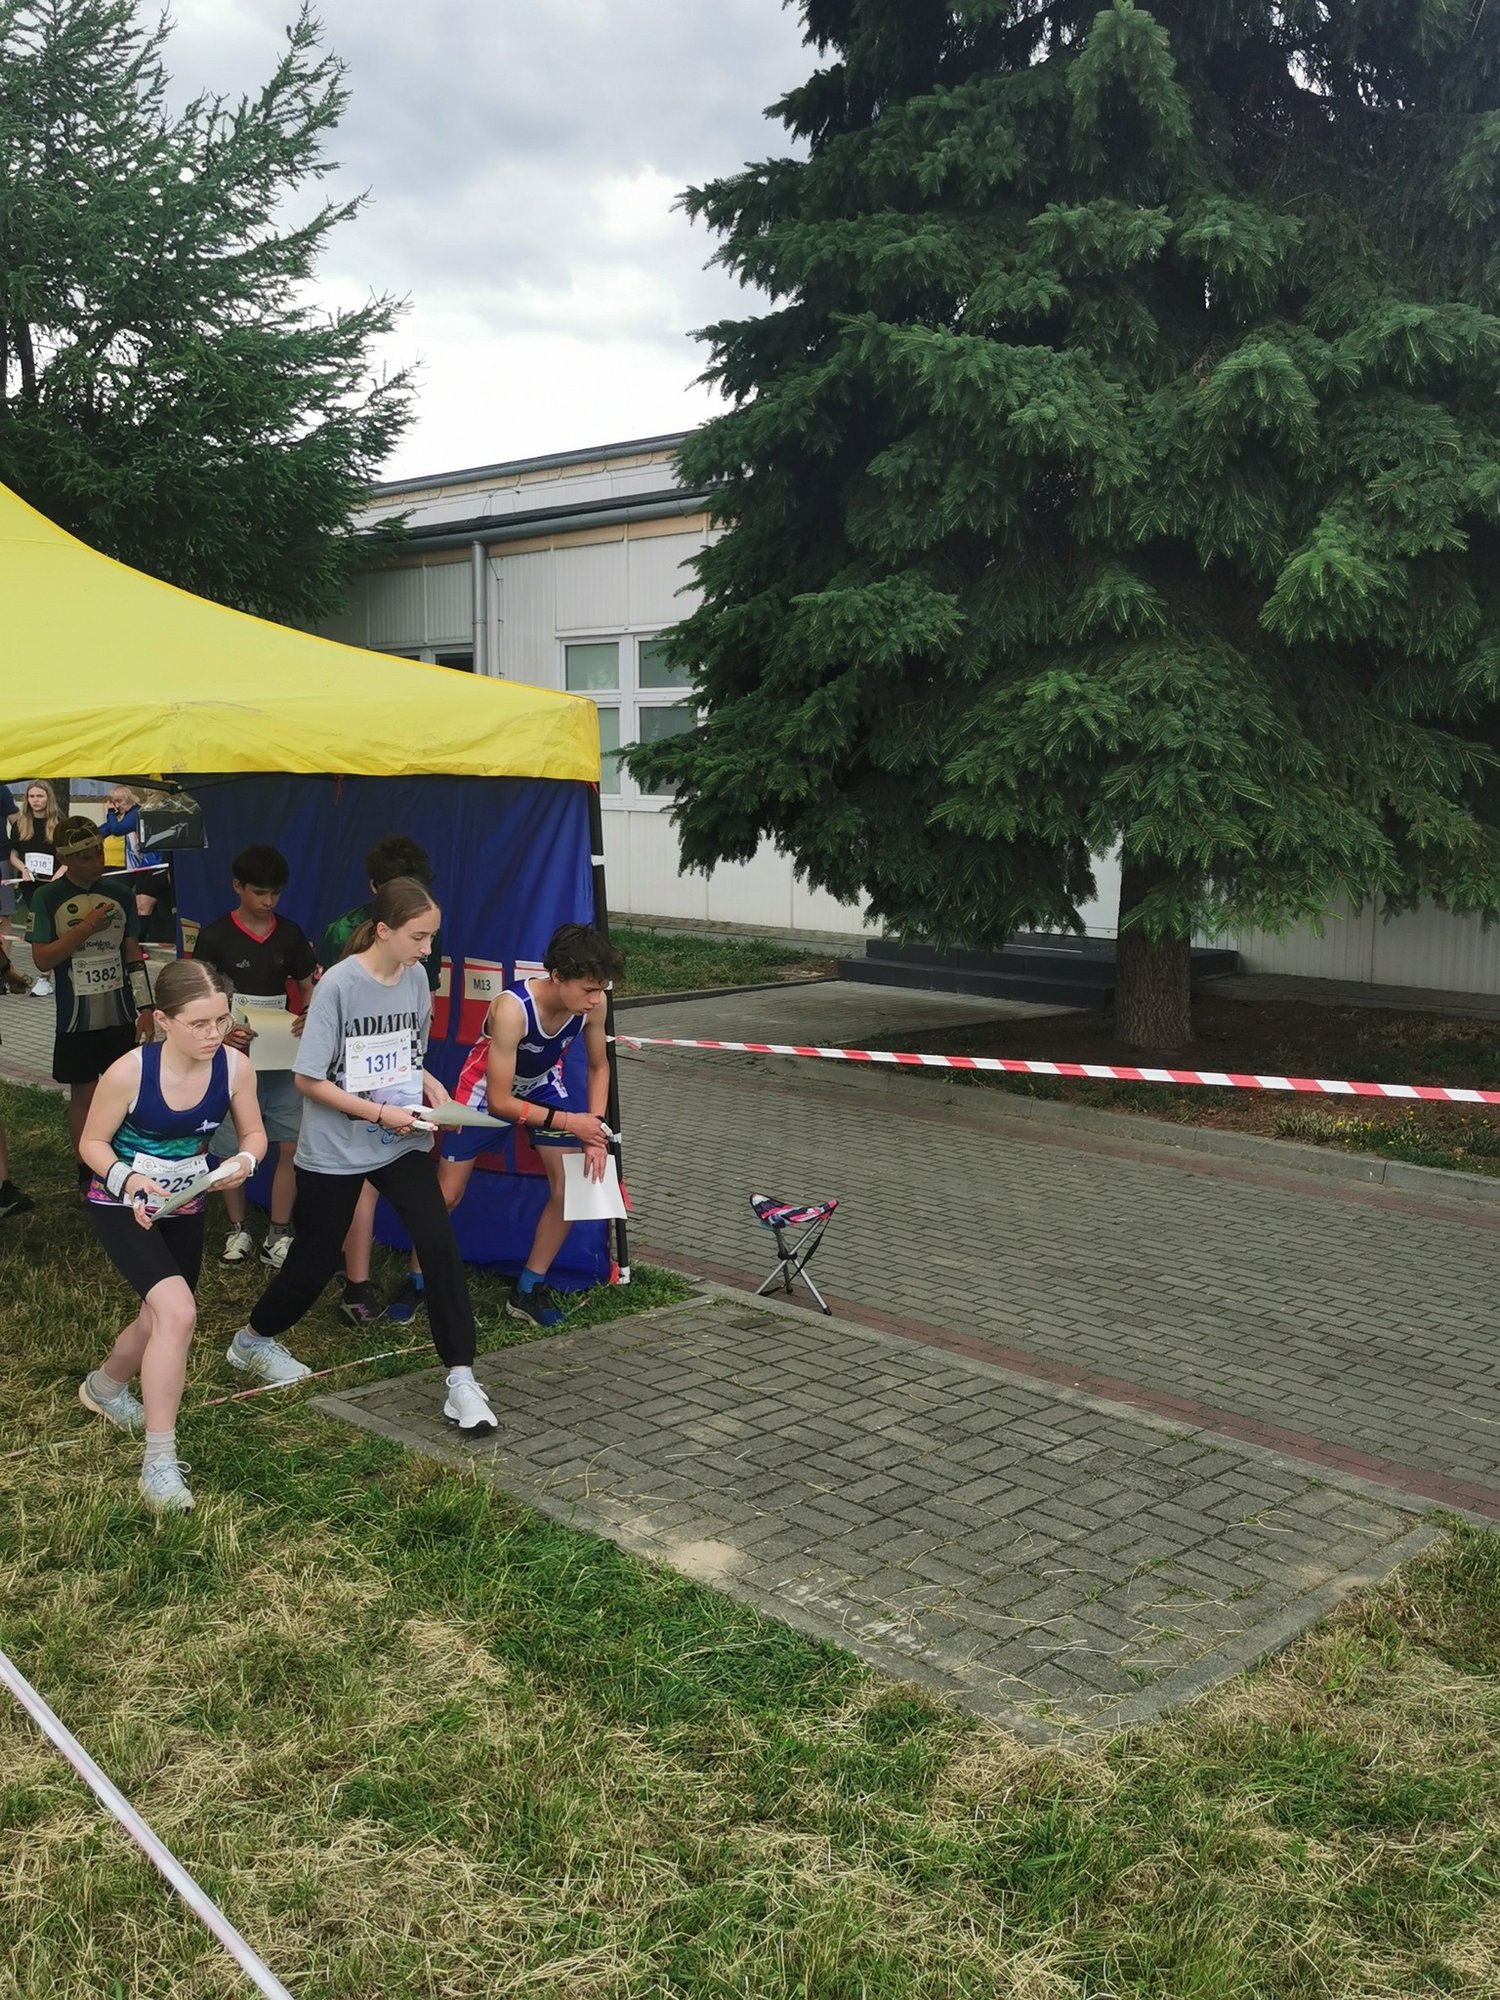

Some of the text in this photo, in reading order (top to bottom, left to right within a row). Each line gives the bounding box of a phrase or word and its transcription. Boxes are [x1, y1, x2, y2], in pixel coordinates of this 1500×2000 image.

[85, 966, 117, 983] 1382
[473, 978, 491, 991] M13
[366, 1051, 397, 1074] 1311
[151, 1173, 196, 1194] 225
